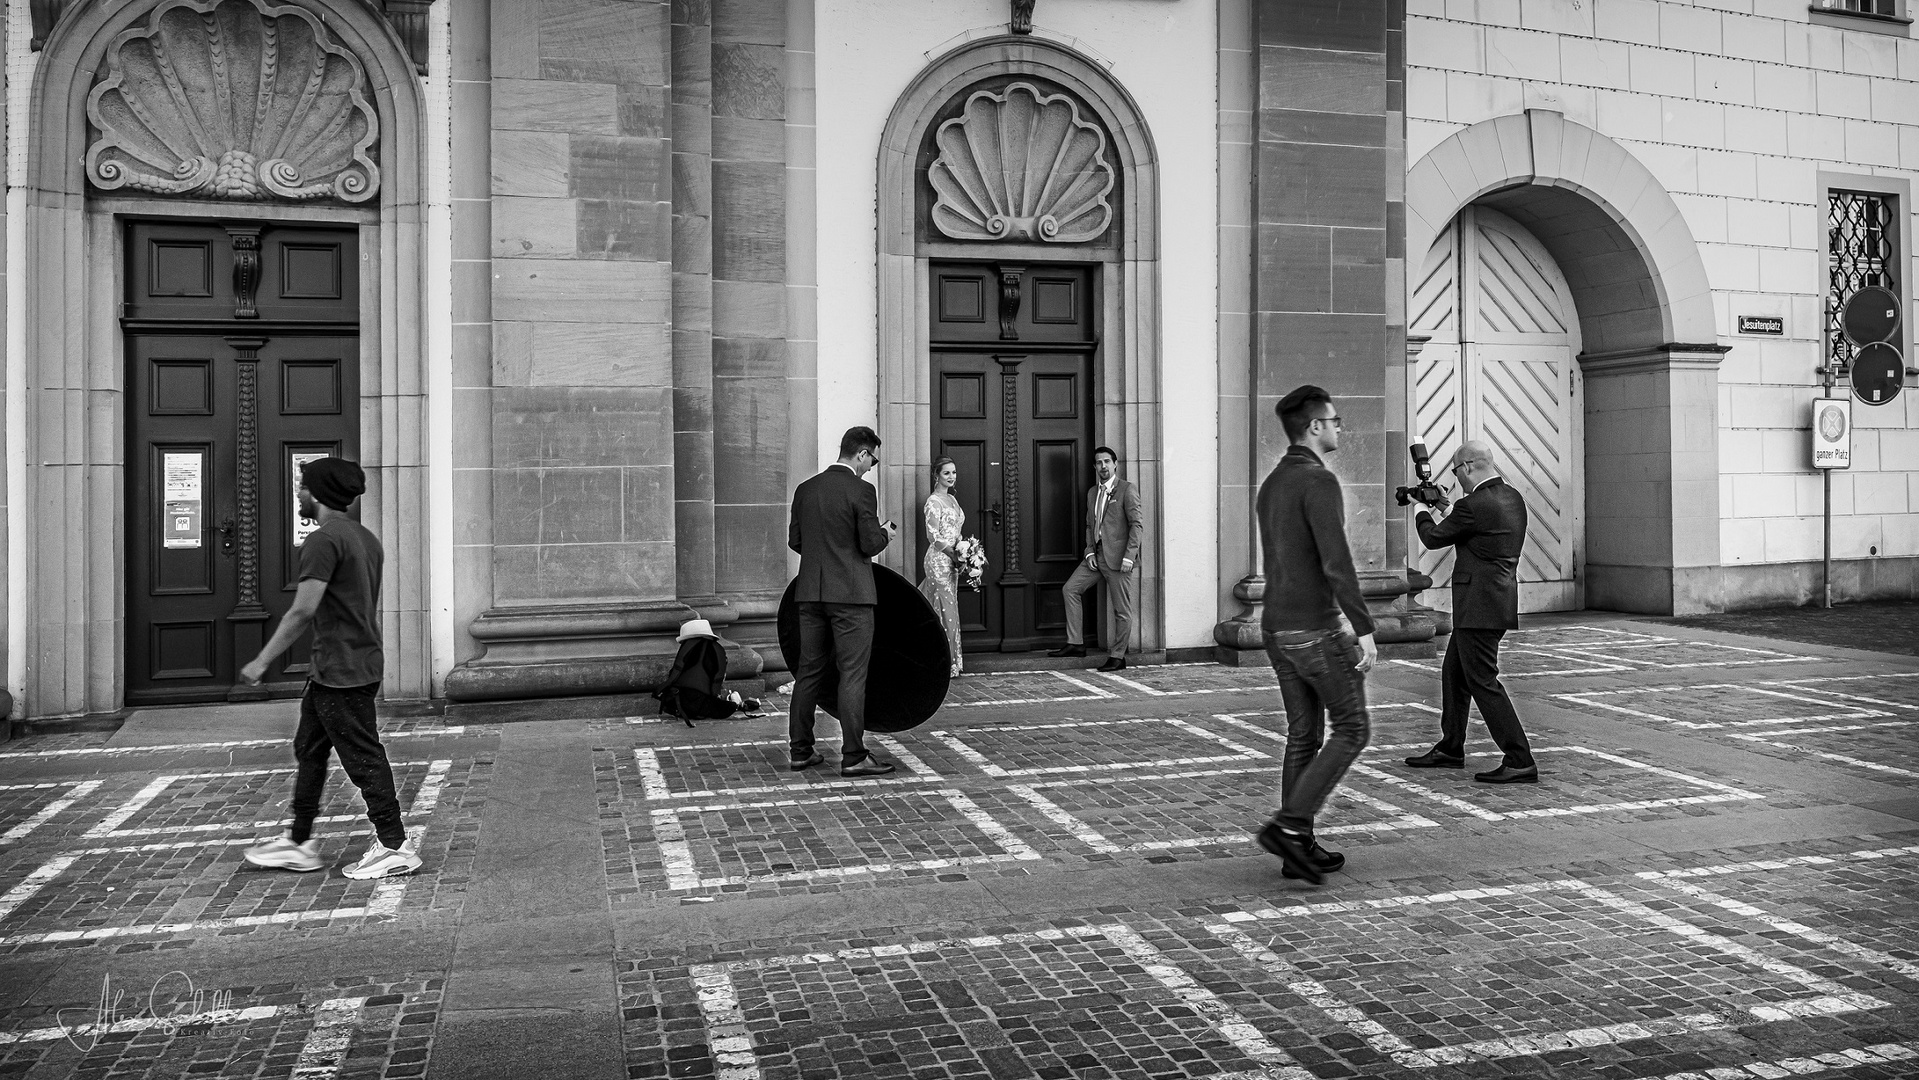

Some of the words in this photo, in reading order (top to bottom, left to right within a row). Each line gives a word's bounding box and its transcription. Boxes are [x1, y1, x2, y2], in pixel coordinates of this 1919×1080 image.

[1742, 318, 1781, 331] Jesuitenplatz
[1816, 449, 1834, 461] ganzer
[1835, 448, 1848, 460] Platz
